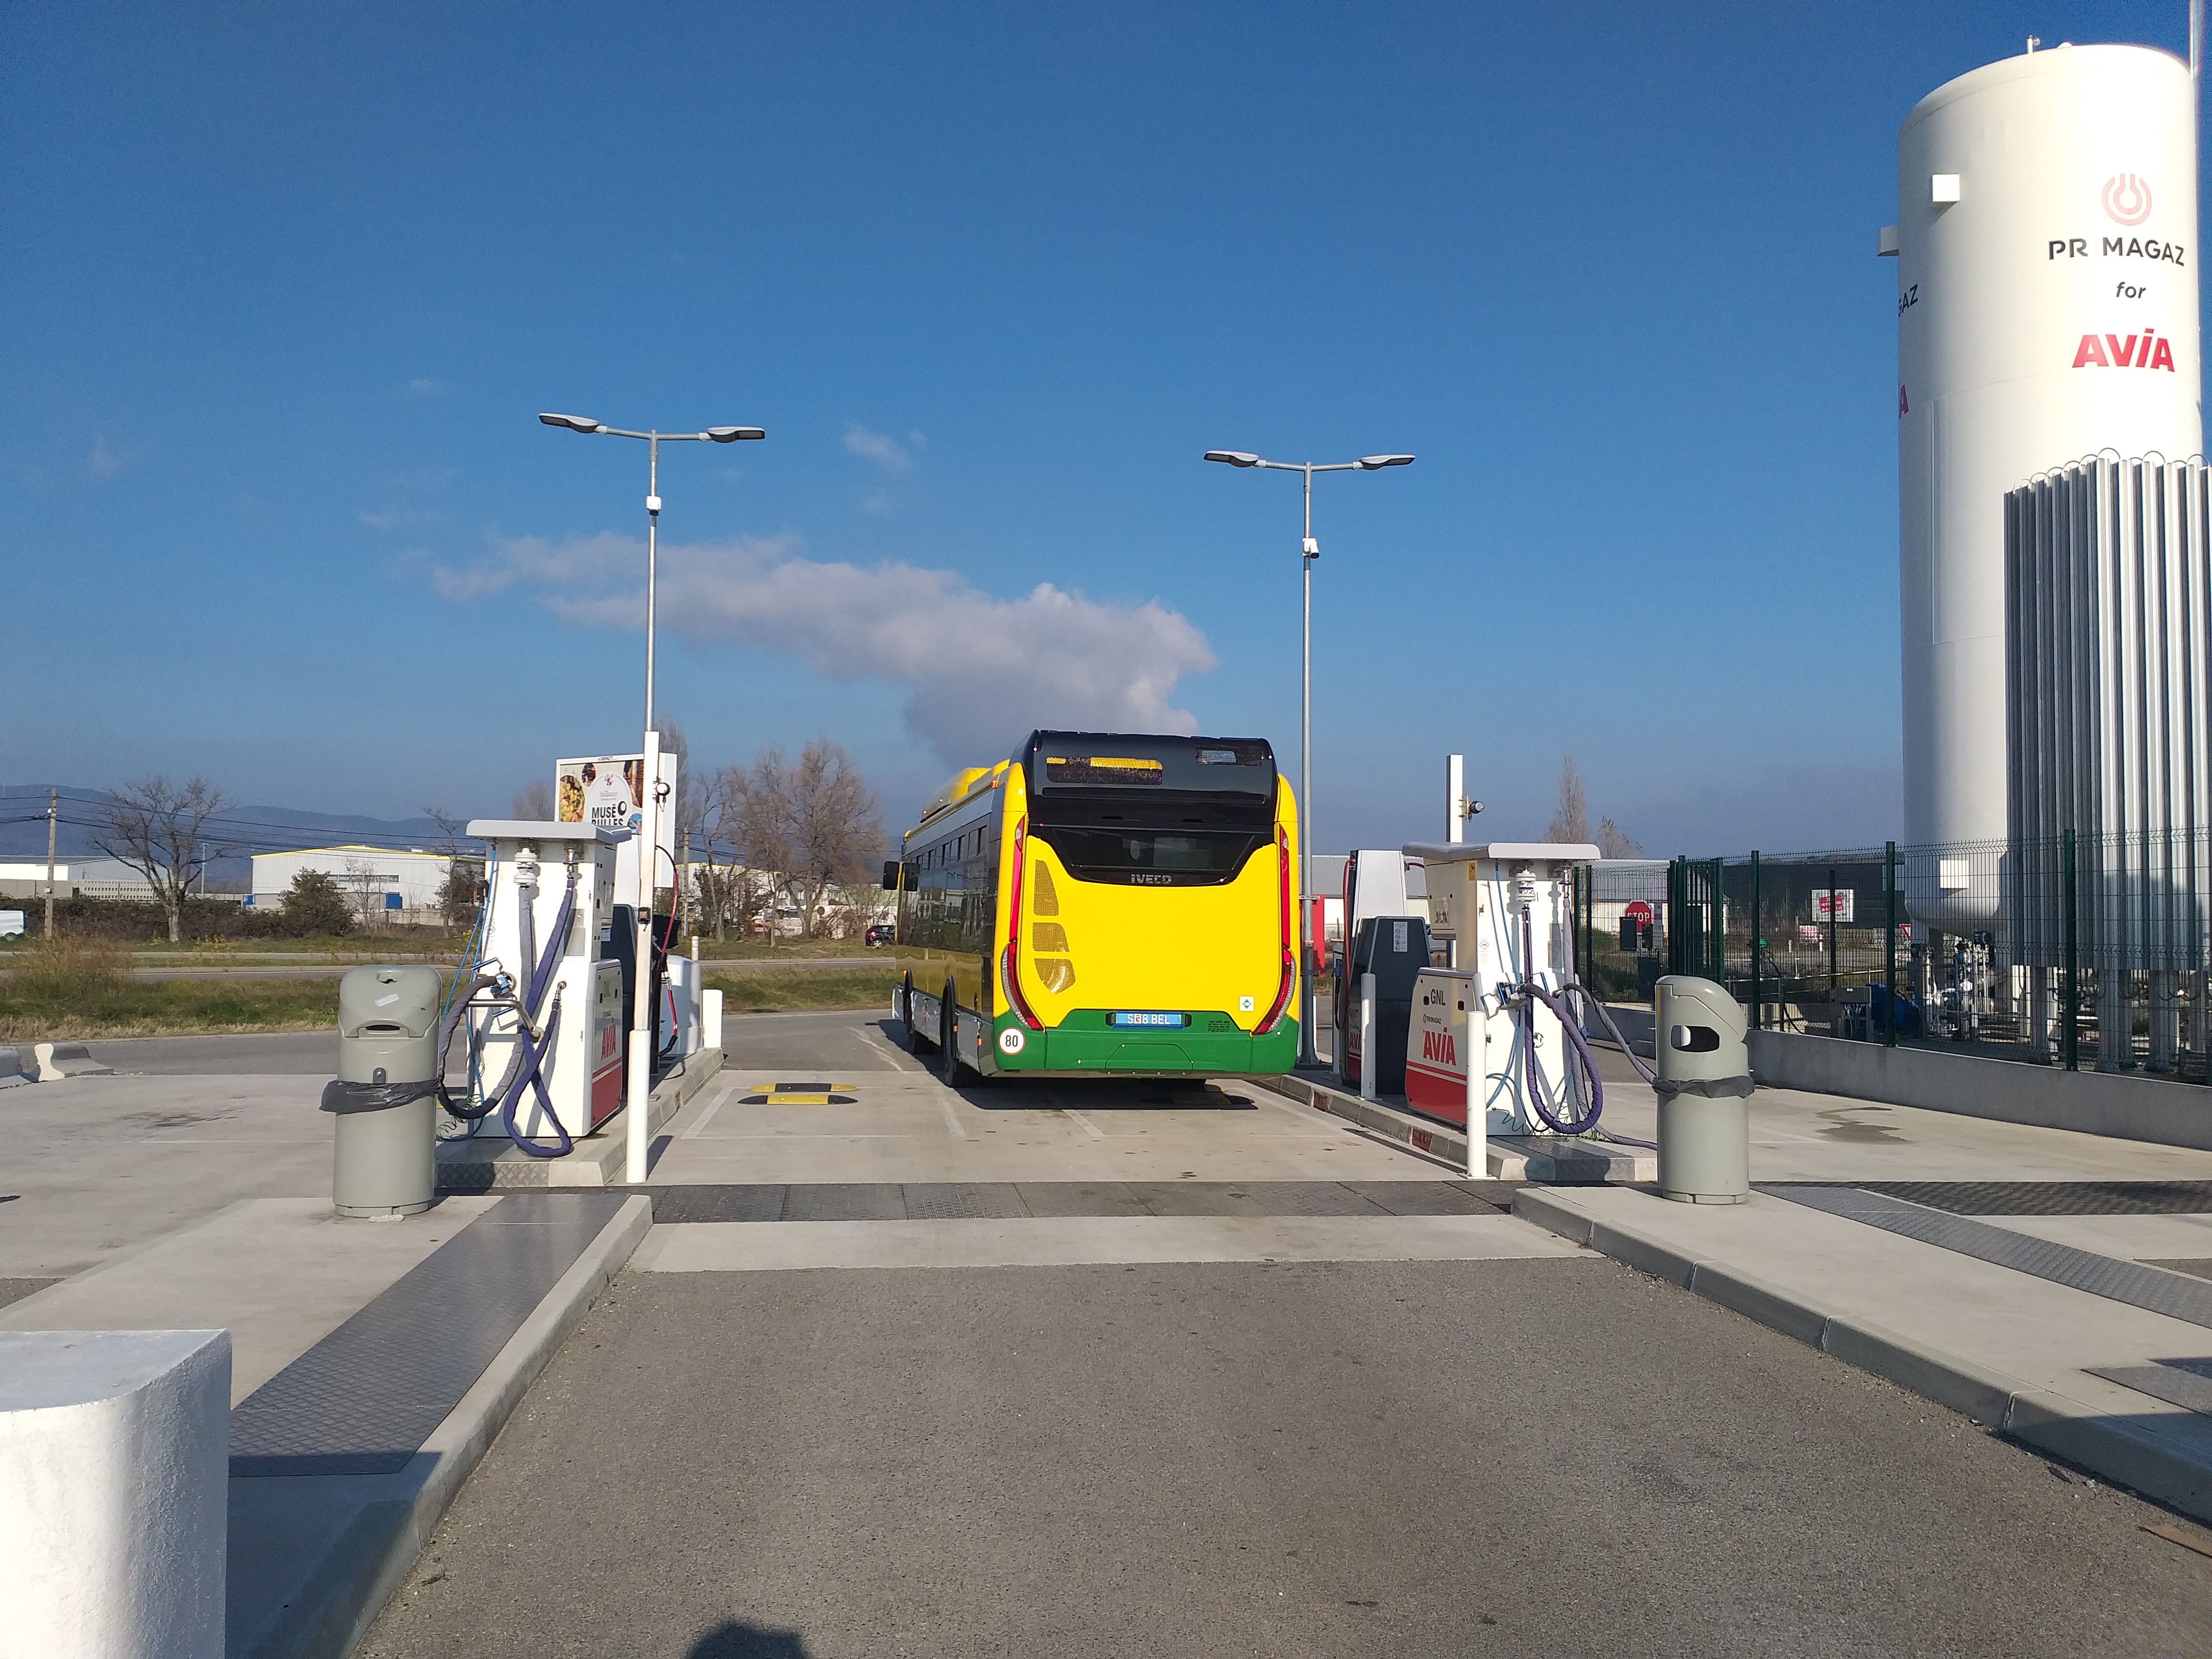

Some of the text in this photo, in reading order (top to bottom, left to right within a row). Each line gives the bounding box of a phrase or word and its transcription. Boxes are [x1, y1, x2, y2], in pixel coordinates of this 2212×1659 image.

[2049, 237, 2184, 267] PRMAGAZ
[2116, 281, 2146, 299] for
[1130, 874, 1172, 884] IVECO
[1431, 988, 1446, 1006] GNL
[1151, 1014, 1170, 1024] BEL
[1005, 1034, 1018, 1047] 80
